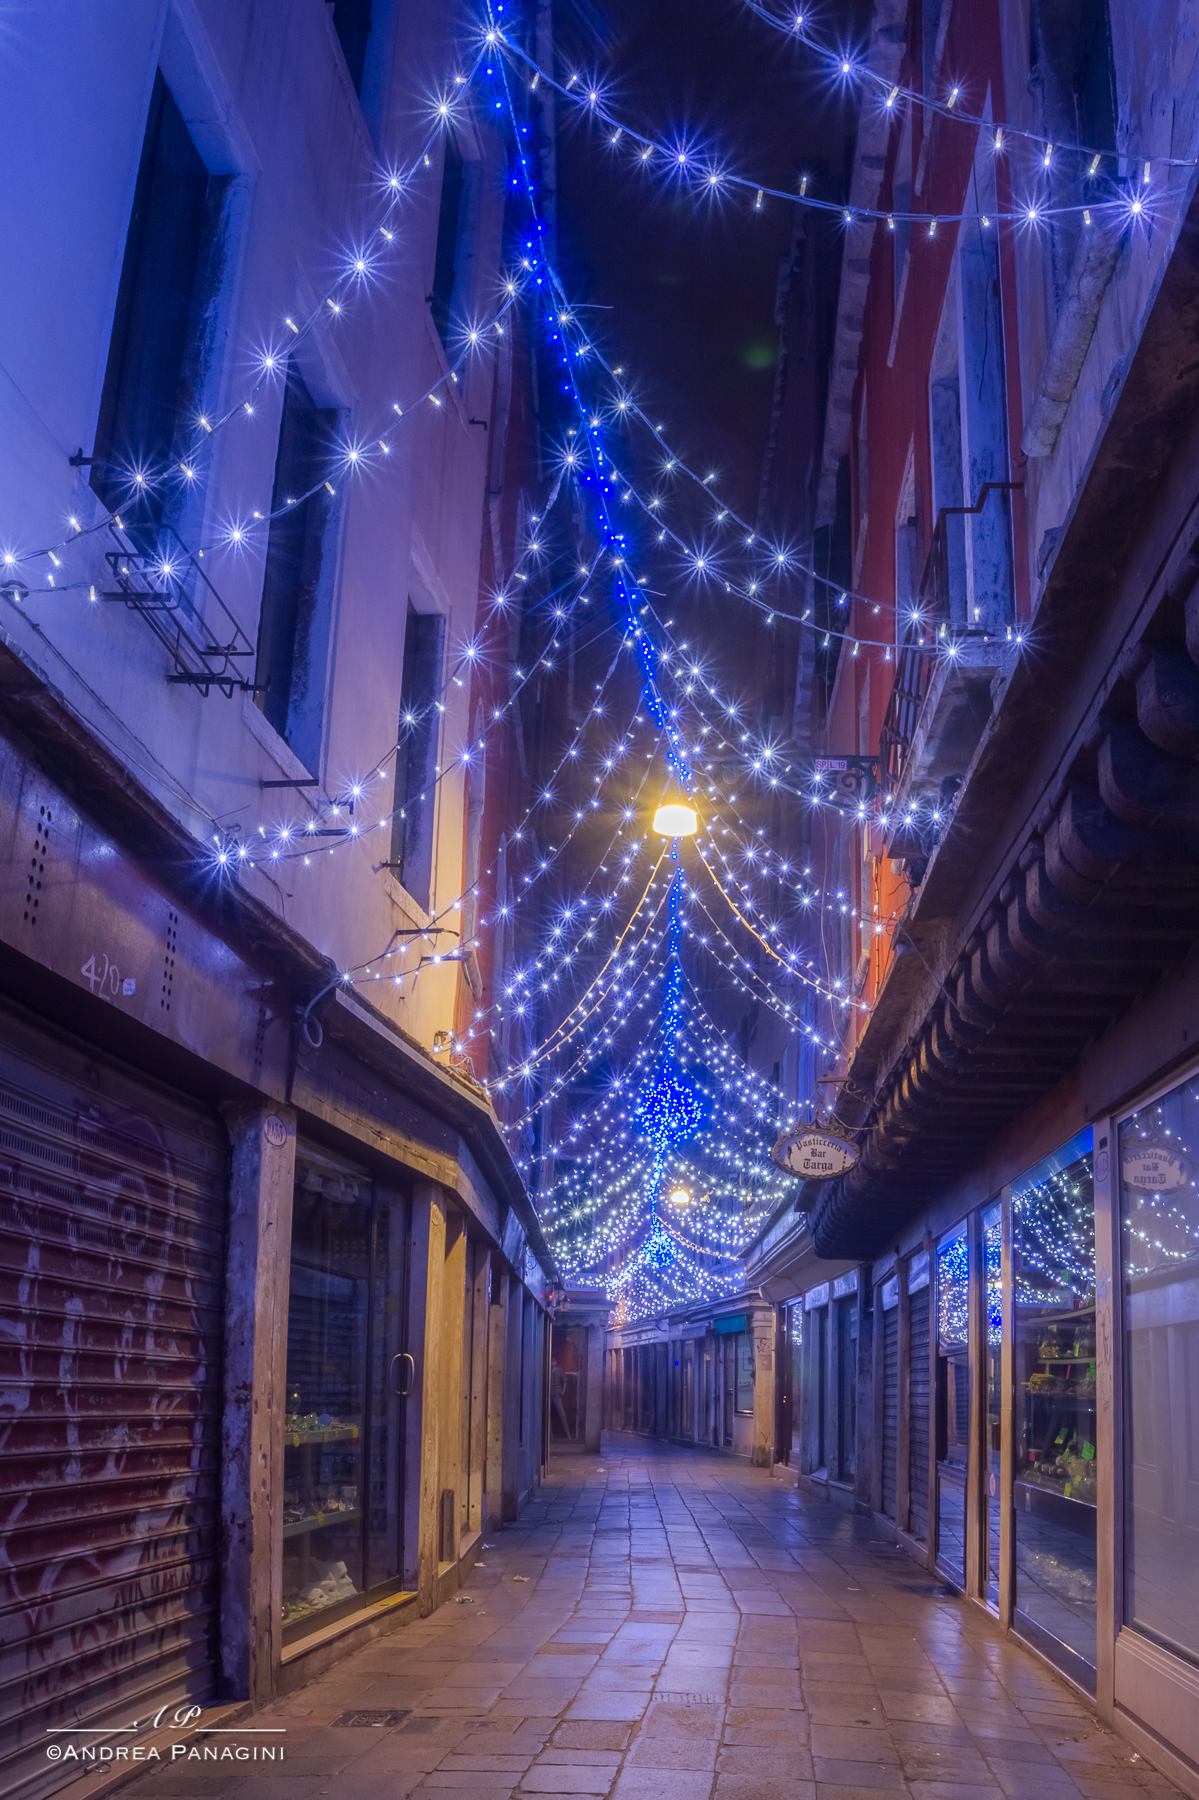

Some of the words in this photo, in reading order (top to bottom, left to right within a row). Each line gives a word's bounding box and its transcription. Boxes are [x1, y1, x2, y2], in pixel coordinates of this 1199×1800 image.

[795, 1137, 842, 1153] Pasticceria
[810, 1147, 827, 1158] Bar
[802, 1158, 833, 1172] Targa
